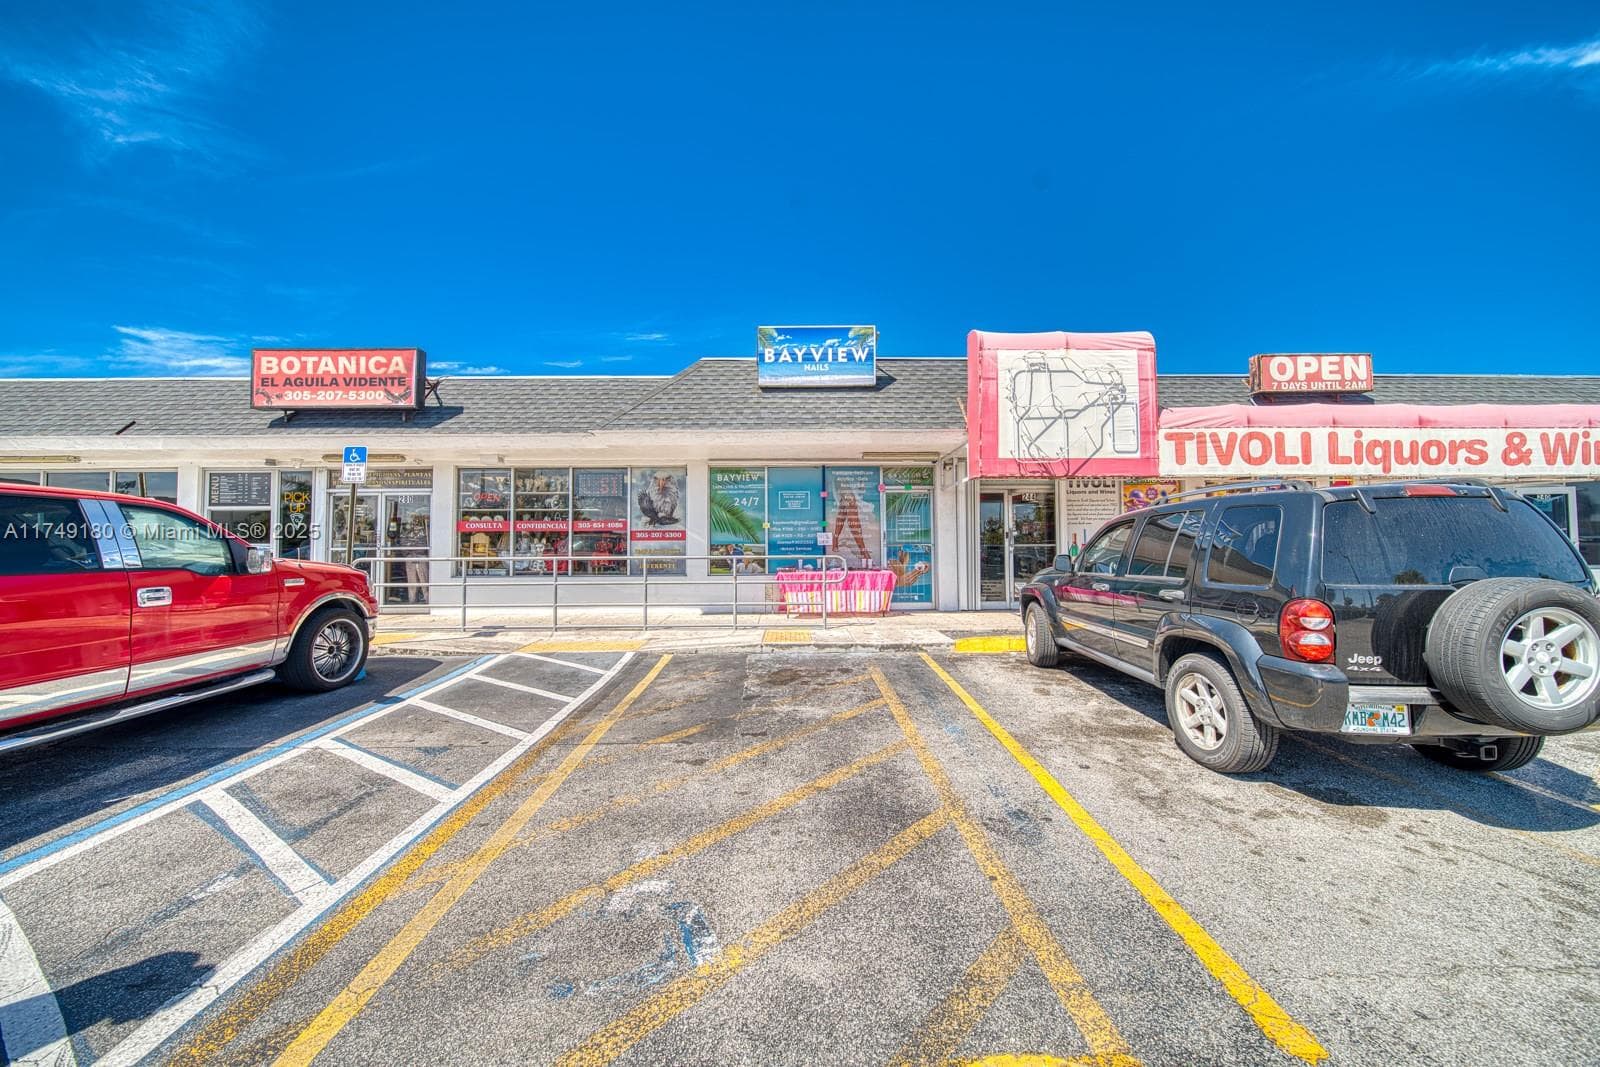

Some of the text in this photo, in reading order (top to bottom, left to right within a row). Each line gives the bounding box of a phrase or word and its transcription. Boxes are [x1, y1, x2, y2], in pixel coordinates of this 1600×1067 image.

[764, 347, 869, 363] BAYVIEW
[260, 356, 407, 375] BOTANICA
[804, 363, 830, 371] NAILS
[1269, 356, 1368, 381] OPEN
[260, 377, 406, 387] EL AGUILA VIDENTE
[1271, 381, 1367, 390] 7 DAYS UNTIL 2AM
[284, 390, 384, 401] 305-207-5300
[1164, 430, 1600, 474] TIVOLI Liquors & Wi
[717, 473, 759, 481] BAYVIEW
[211, 476, 220, 503] MENU
[284, 492, 311, 503] PICK
[734, 496, 759, 507] 24/7
[289, 503, 306, 513] UP
[1347, 653, 1382, 665] Jeep
[1382, 712, 1406, 727] M42
